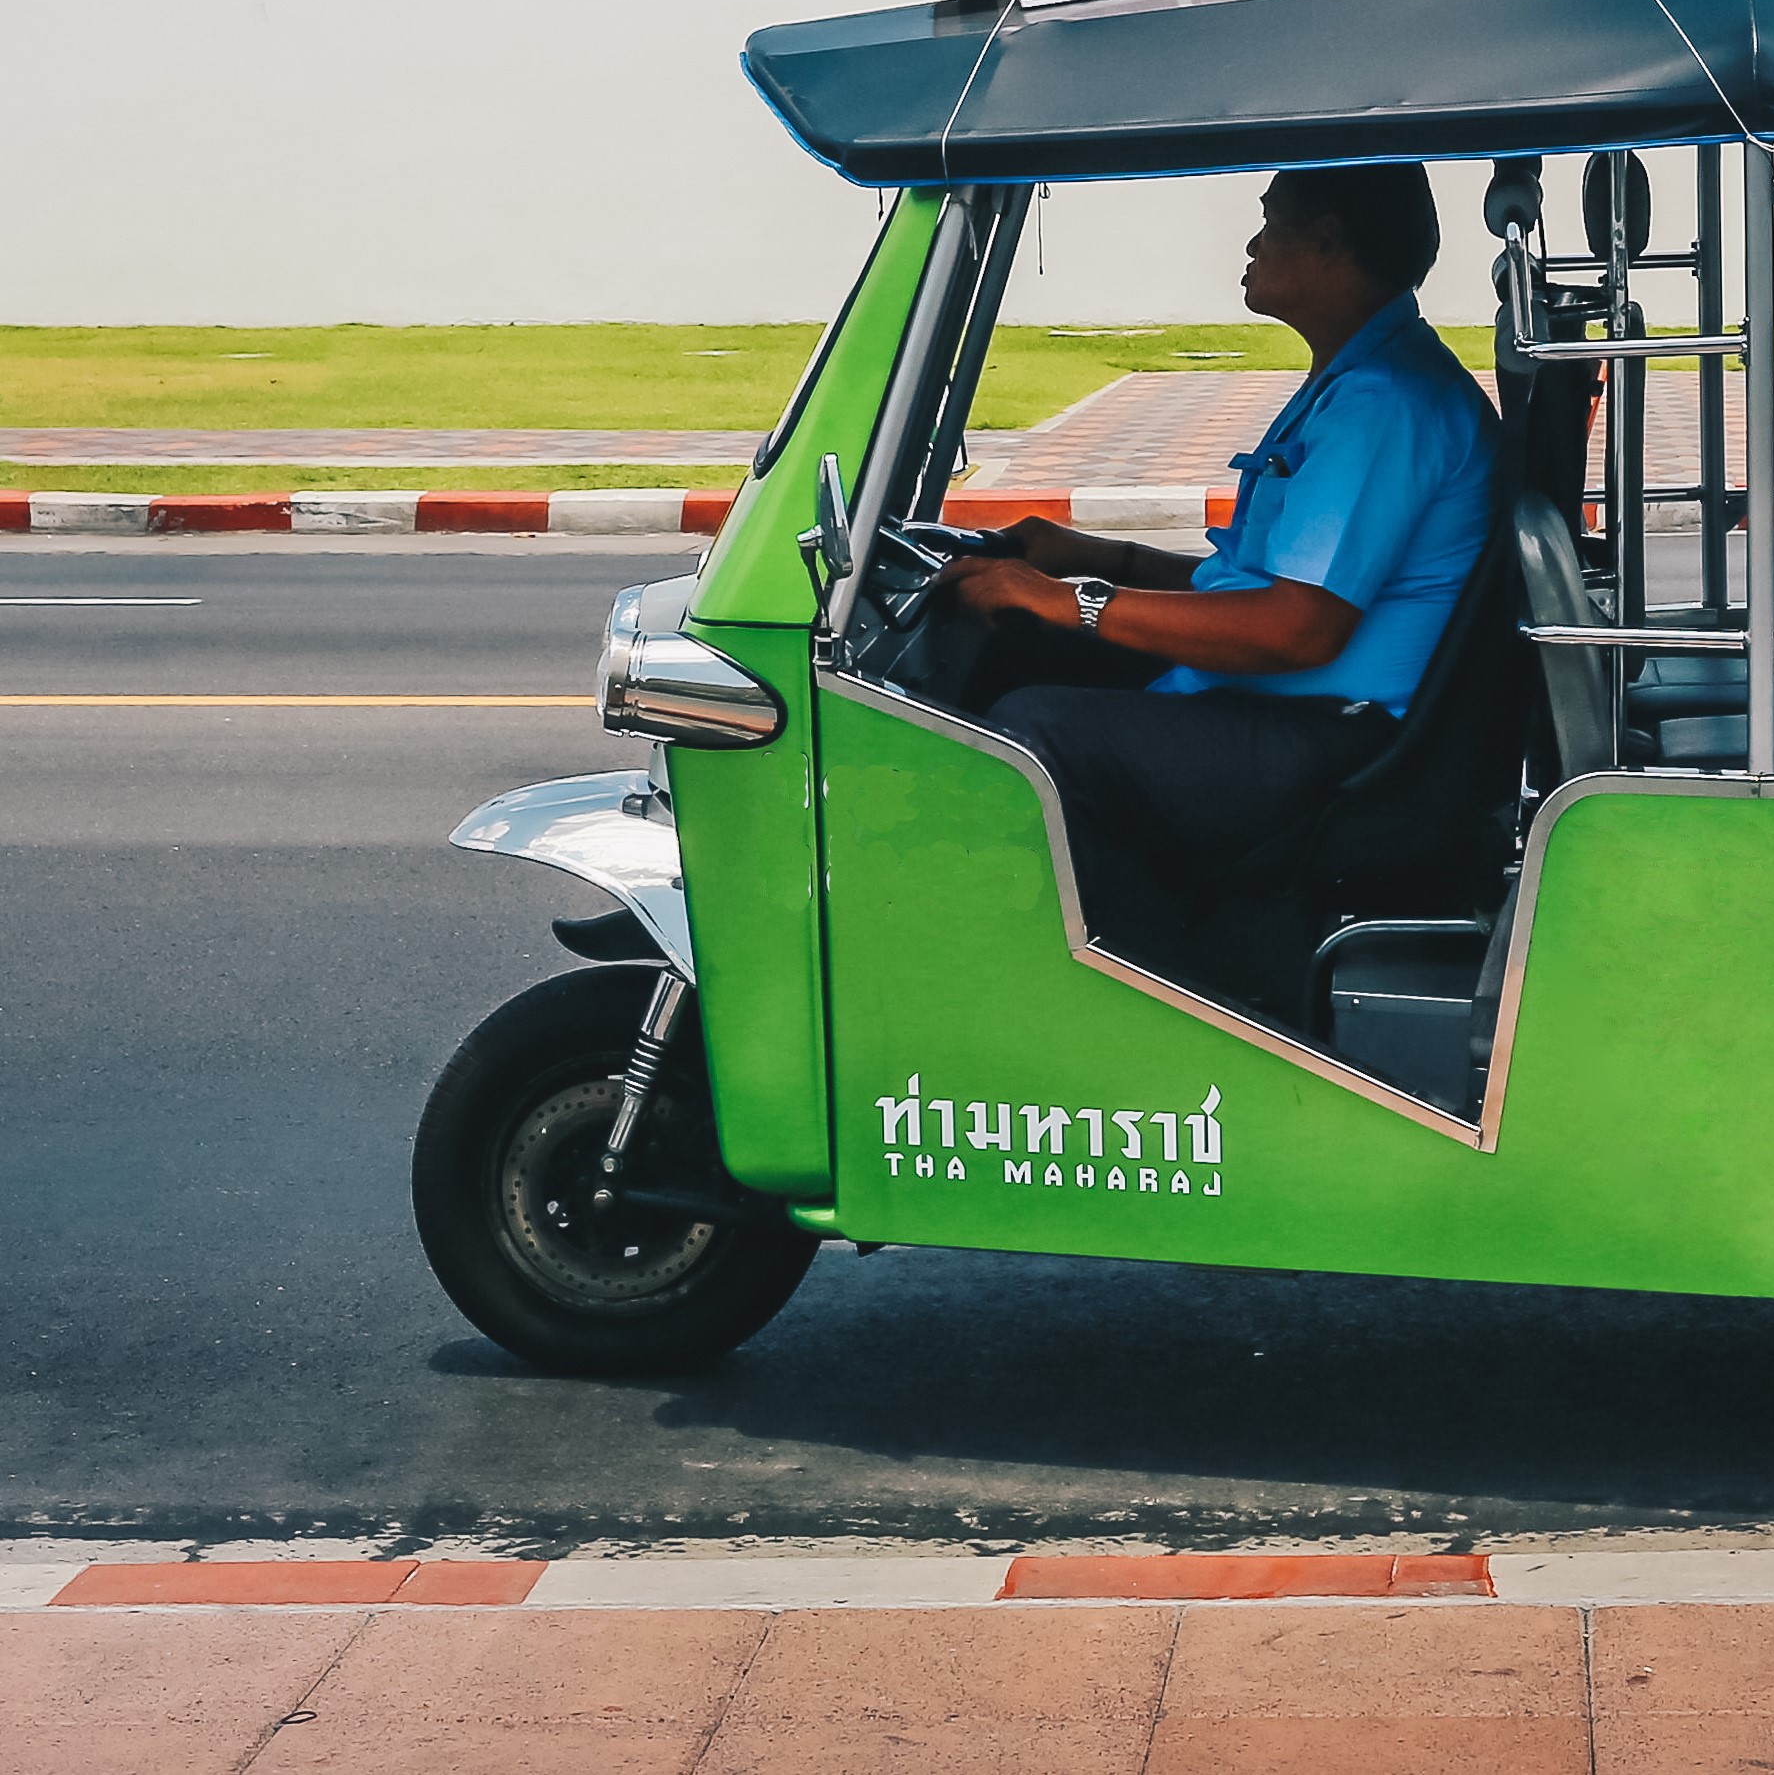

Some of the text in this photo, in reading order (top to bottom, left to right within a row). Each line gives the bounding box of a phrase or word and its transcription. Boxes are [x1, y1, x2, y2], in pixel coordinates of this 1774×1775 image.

[874, 1072, 1222, 1164] ท่ามหาราช
[883, 1152, 1222, 1197] THA MAHARAJ
